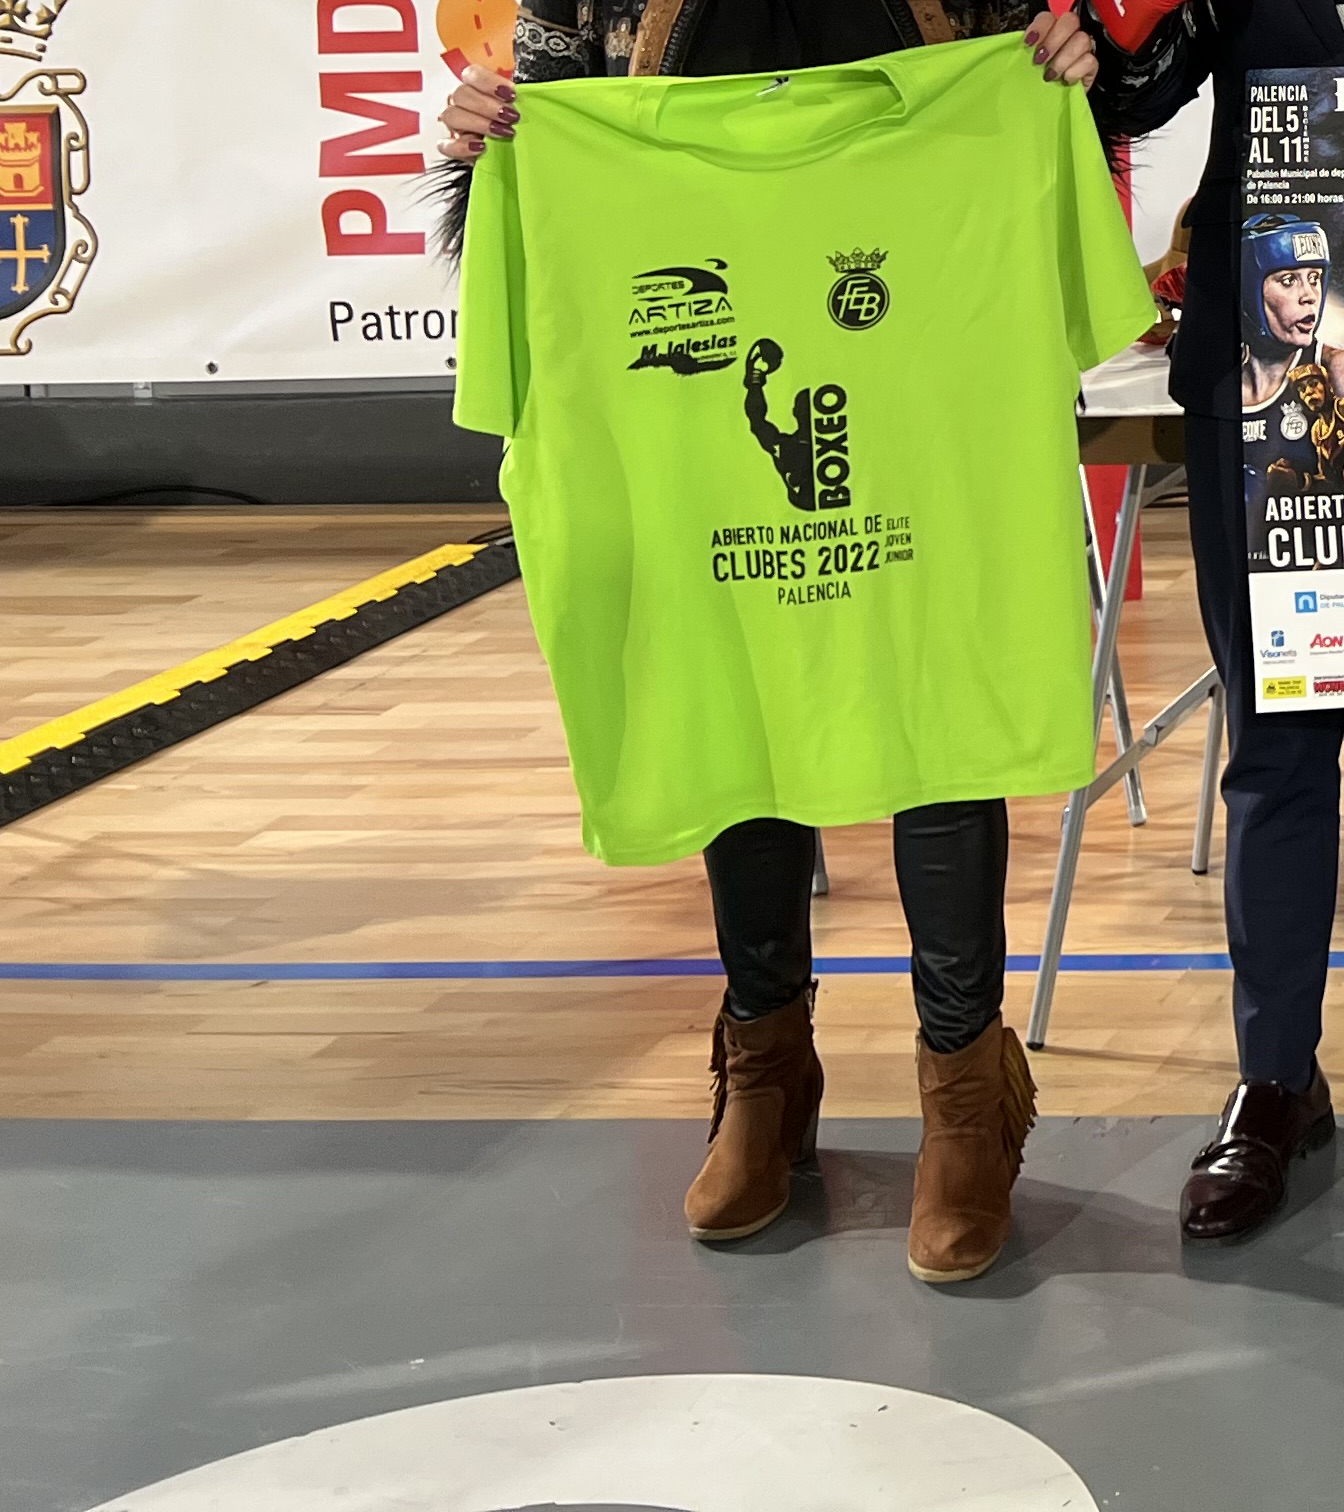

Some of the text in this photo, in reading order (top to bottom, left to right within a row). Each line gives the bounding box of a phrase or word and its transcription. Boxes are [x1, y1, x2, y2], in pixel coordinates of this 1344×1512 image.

[1250, 84, 1309, 103] PALENCIA
[1250, 105, 1300, 134] DEL 5
[1248, 136, 1302, 164] AL 11
[1246, 180, 1290, 190] de Palencia
[1280, 168, 1318, 179] Municipal
[1319, 168, 1329, 177] de
[1246, 193, 1344, 204] De 16:00 a 21:00 horas
[1293, 234, 1325, 259] LEONE
[628, 296, 733, 325] ARTIZA
[836, 279, 881, 321] FEB
[813, 383, 852, 510] BOXEO
[711, 514, 882, 549] ABIERTO NACIONAL DE
[886, 515, 911, 531] ELITE
[884, 533, 912, 547] JOVEN
[712, 540, 881, 583] CLUBES 2022
[884, 548, 914, 564] JUNIOR
[777, 580, 852, 606] PALENCIA
